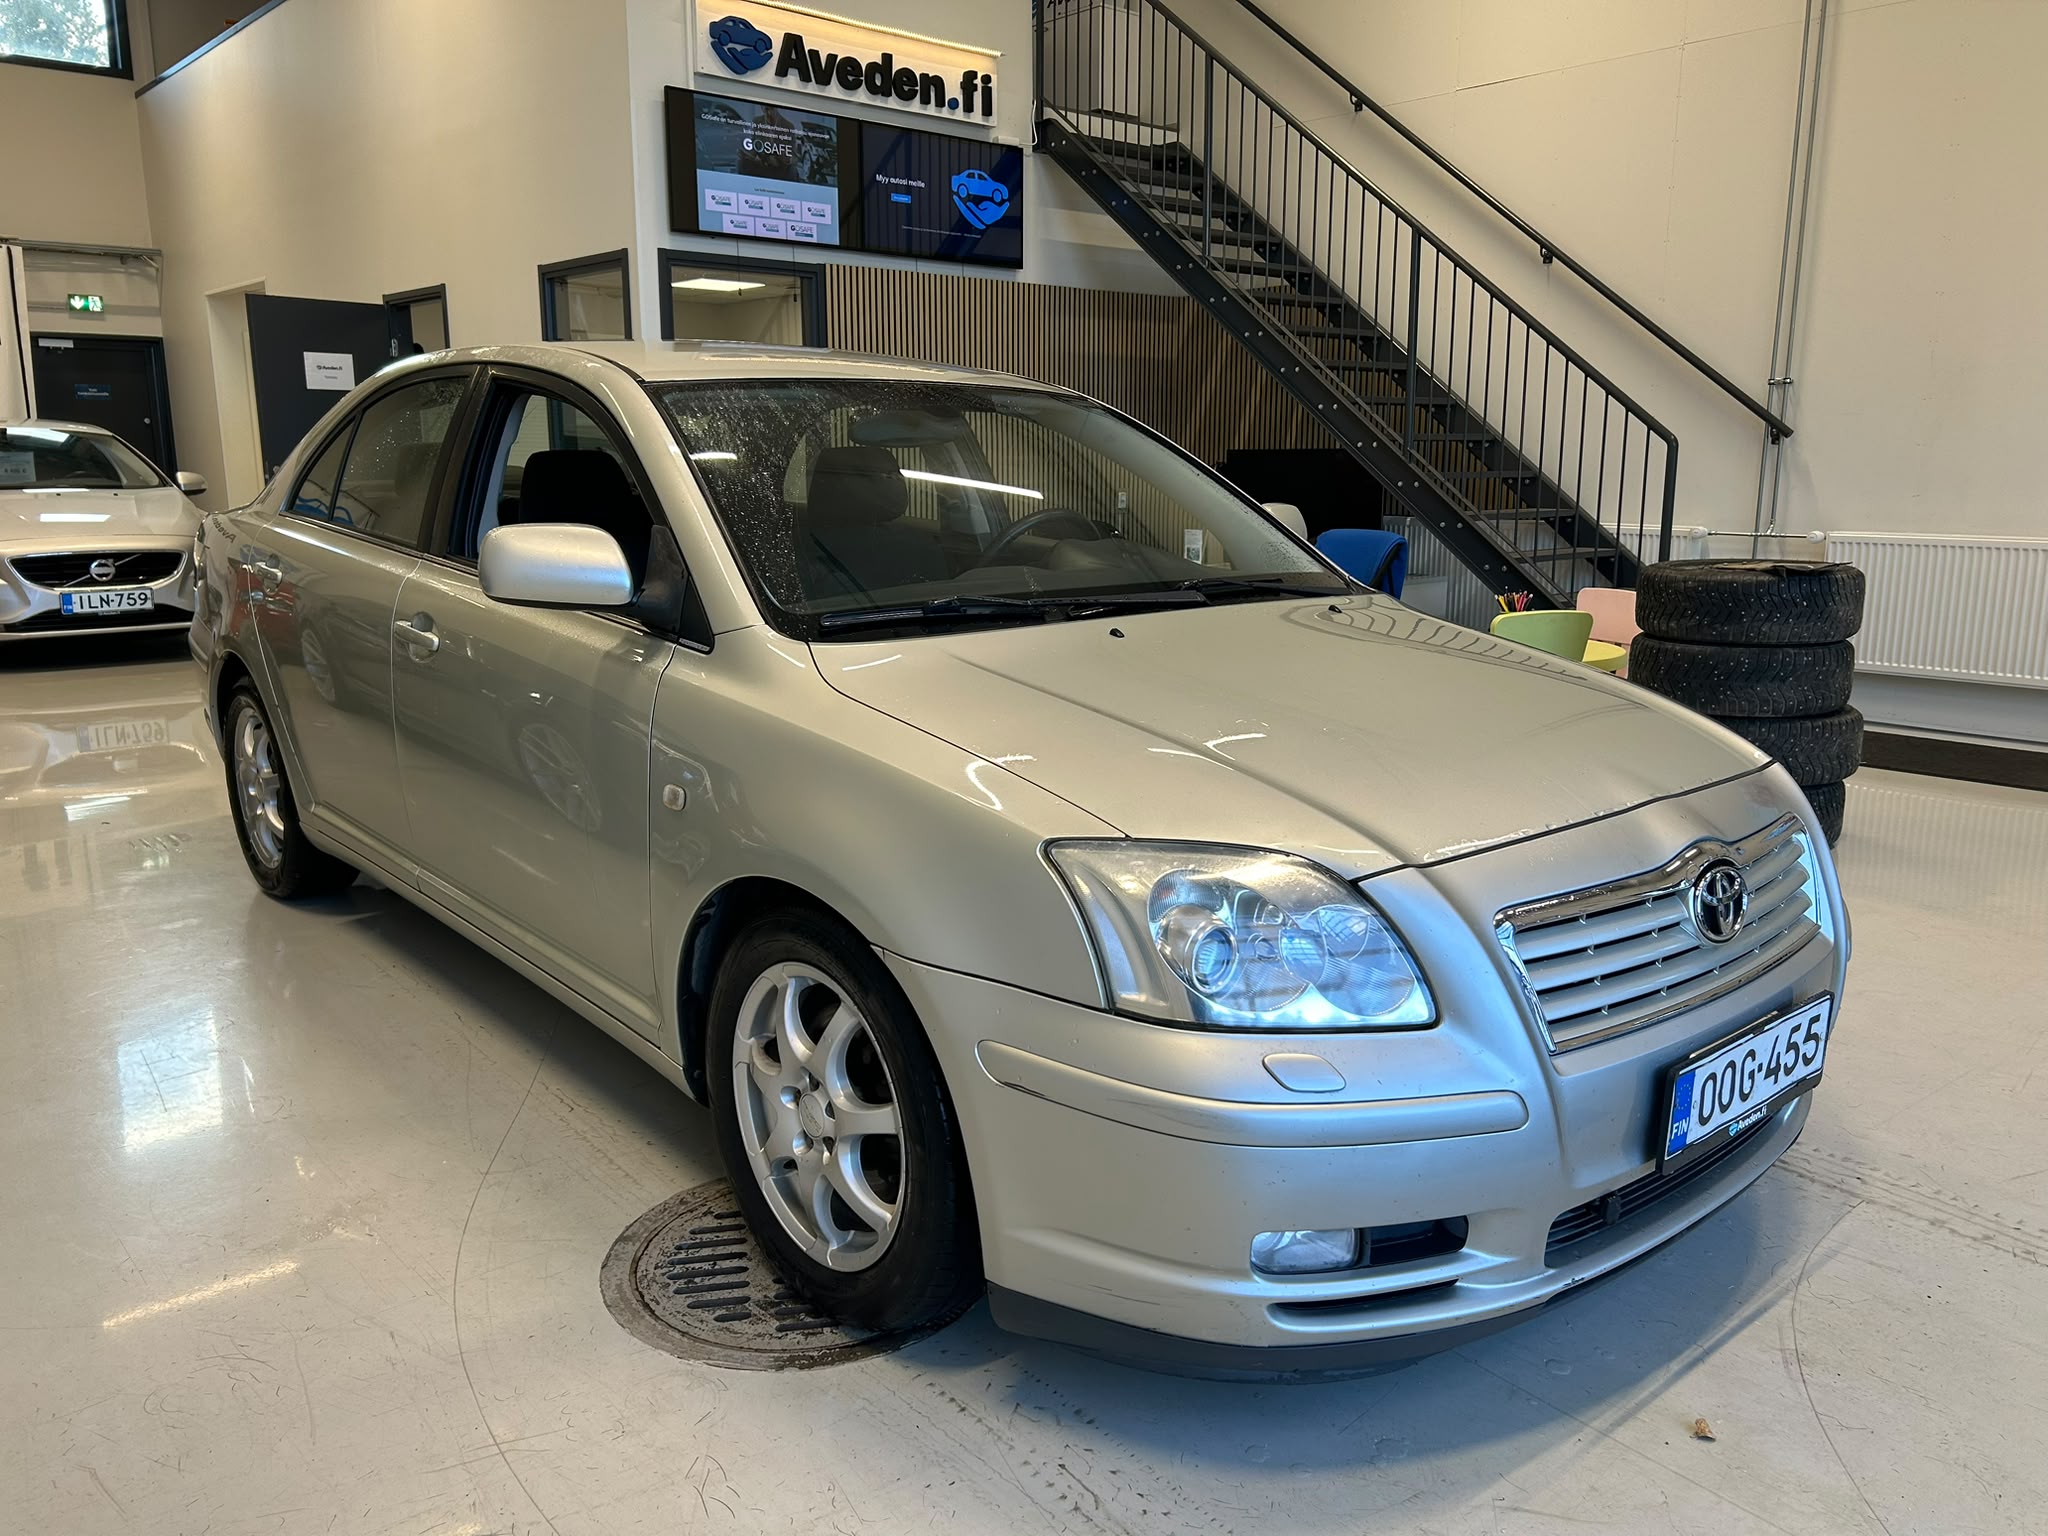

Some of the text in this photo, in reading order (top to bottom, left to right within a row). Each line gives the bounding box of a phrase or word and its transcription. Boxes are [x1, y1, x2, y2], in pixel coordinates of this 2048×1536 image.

[775, 32, 994, 117] Aveden.fi
[743, 138, 793, 158] GOSAFE
[876, 174, 889, 185] Myy
[79, 591, 148, 610] ILN-759
[1671, 1116, 1690, 1140] FIN
